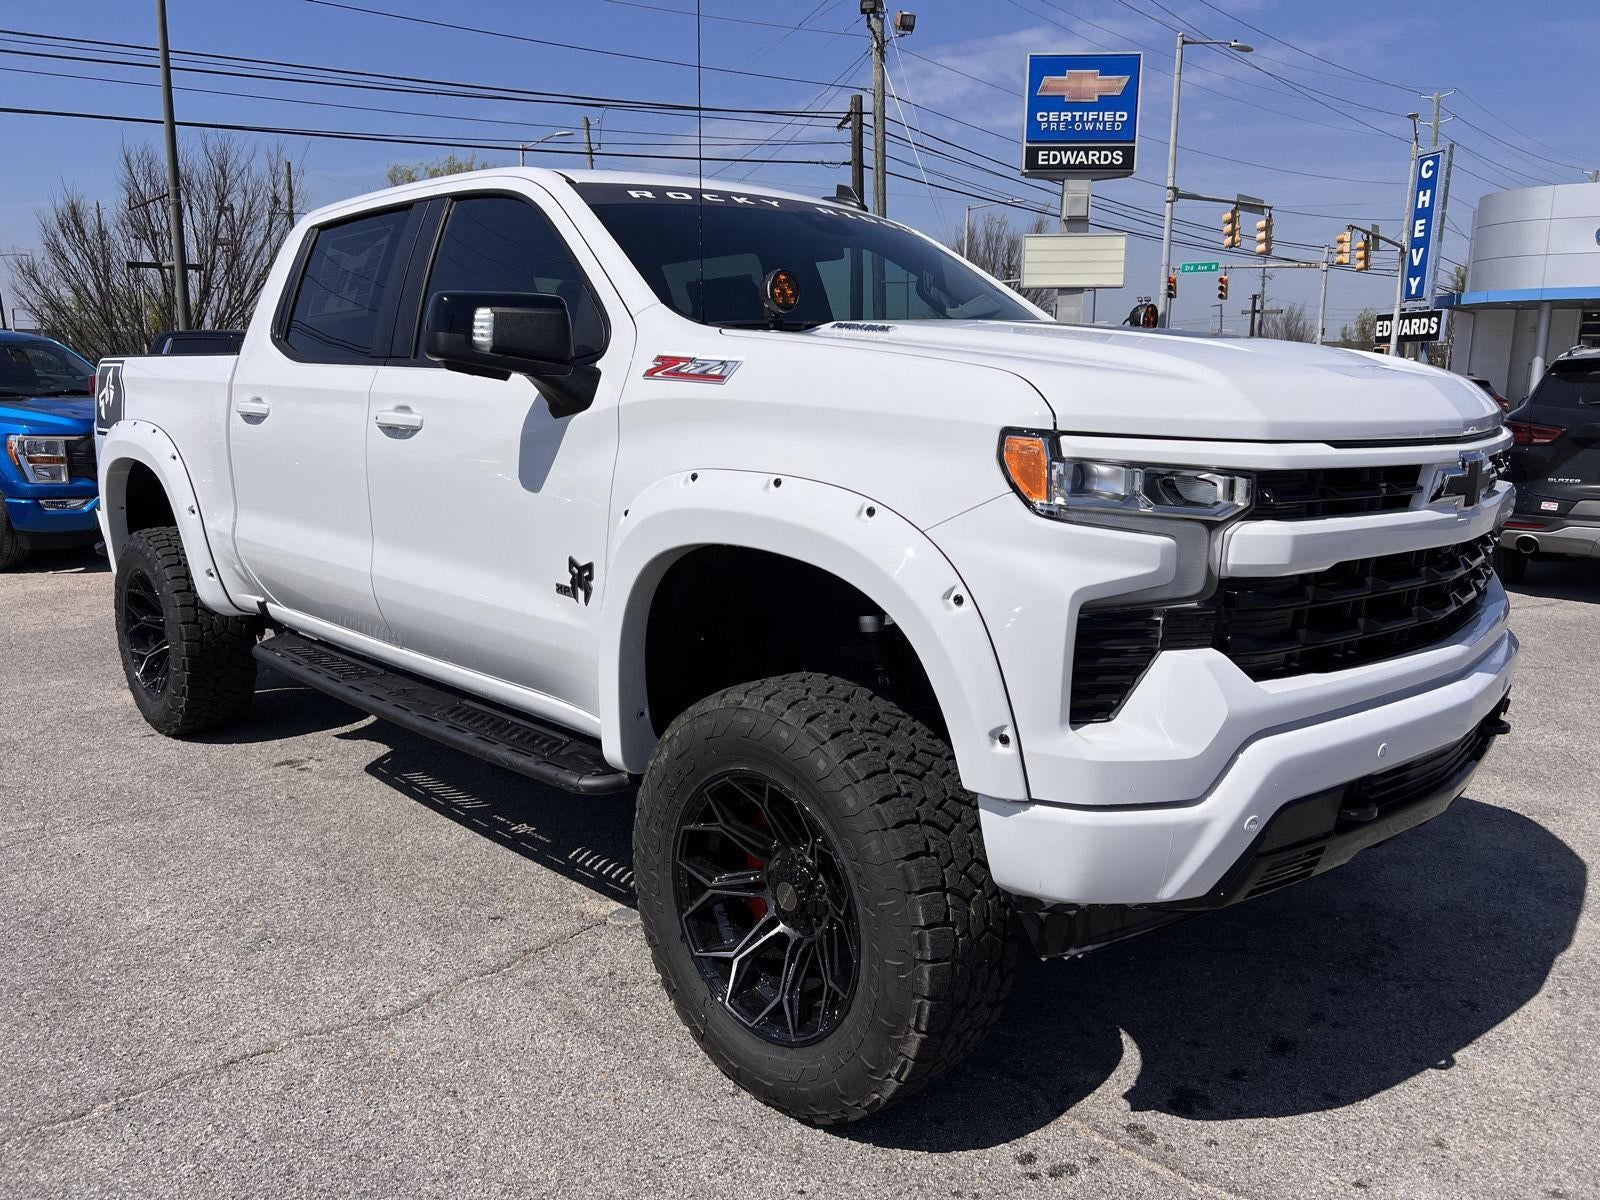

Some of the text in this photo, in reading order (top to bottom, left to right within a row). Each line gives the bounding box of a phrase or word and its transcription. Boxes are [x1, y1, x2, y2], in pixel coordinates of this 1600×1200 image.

[1036, 111, 1128, 122] CERTIFIED
[1041, 122, 1123, 131] PRE-OWNED
[1038, 150, 1123, 165] EDWARDS
[627, 189, 781, 208] ROCKY
[1408, 160, 1435, 295] CHEVY
[1375, 317, 1438, 337] EDARDS
[642, 354, 743, 385] Z71
